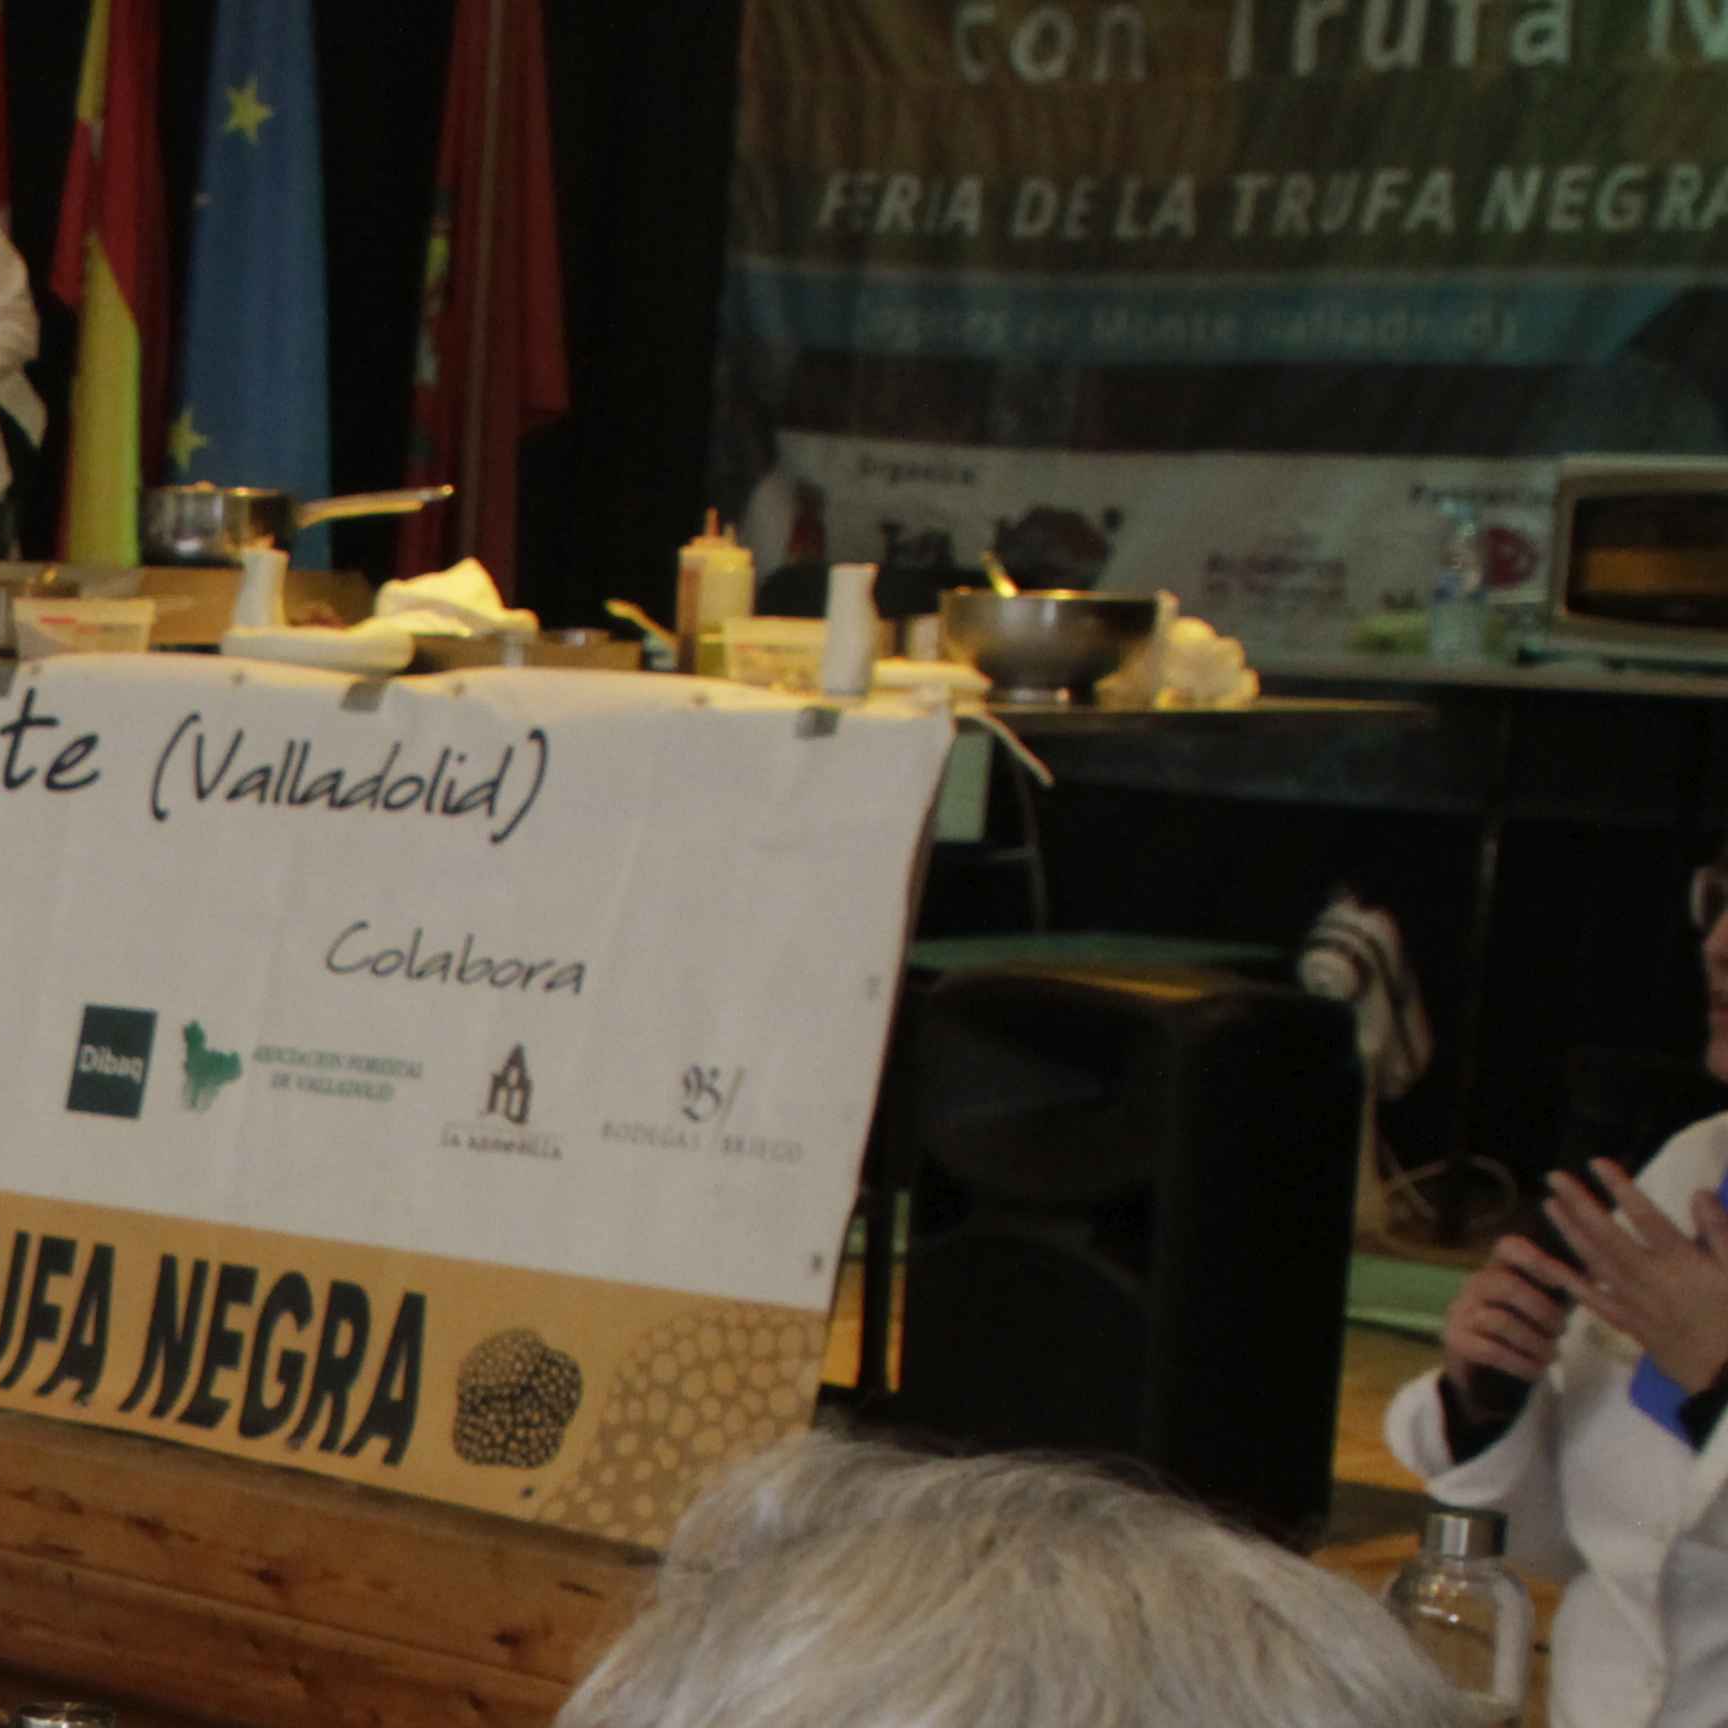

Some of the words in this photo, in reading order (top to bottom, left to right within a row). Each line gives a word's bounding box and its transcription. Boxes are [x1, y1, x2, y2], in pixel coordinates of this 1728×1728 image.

[952, 0, 1147, 84] con
[817, 172, 982, 238] FERIA
[1011, 176, 1093, 240] DE
[1114, 172, 1196, 236] LA
[1231, 168, 1456, 240] TRUFA
[1479, 161, 1728, 233] NEGRA
[148, 712, 551, 844] (Valladolid)
[324, 919, 587, 997] Colabora
[117, 1251, 428, 1466] NEGRA
